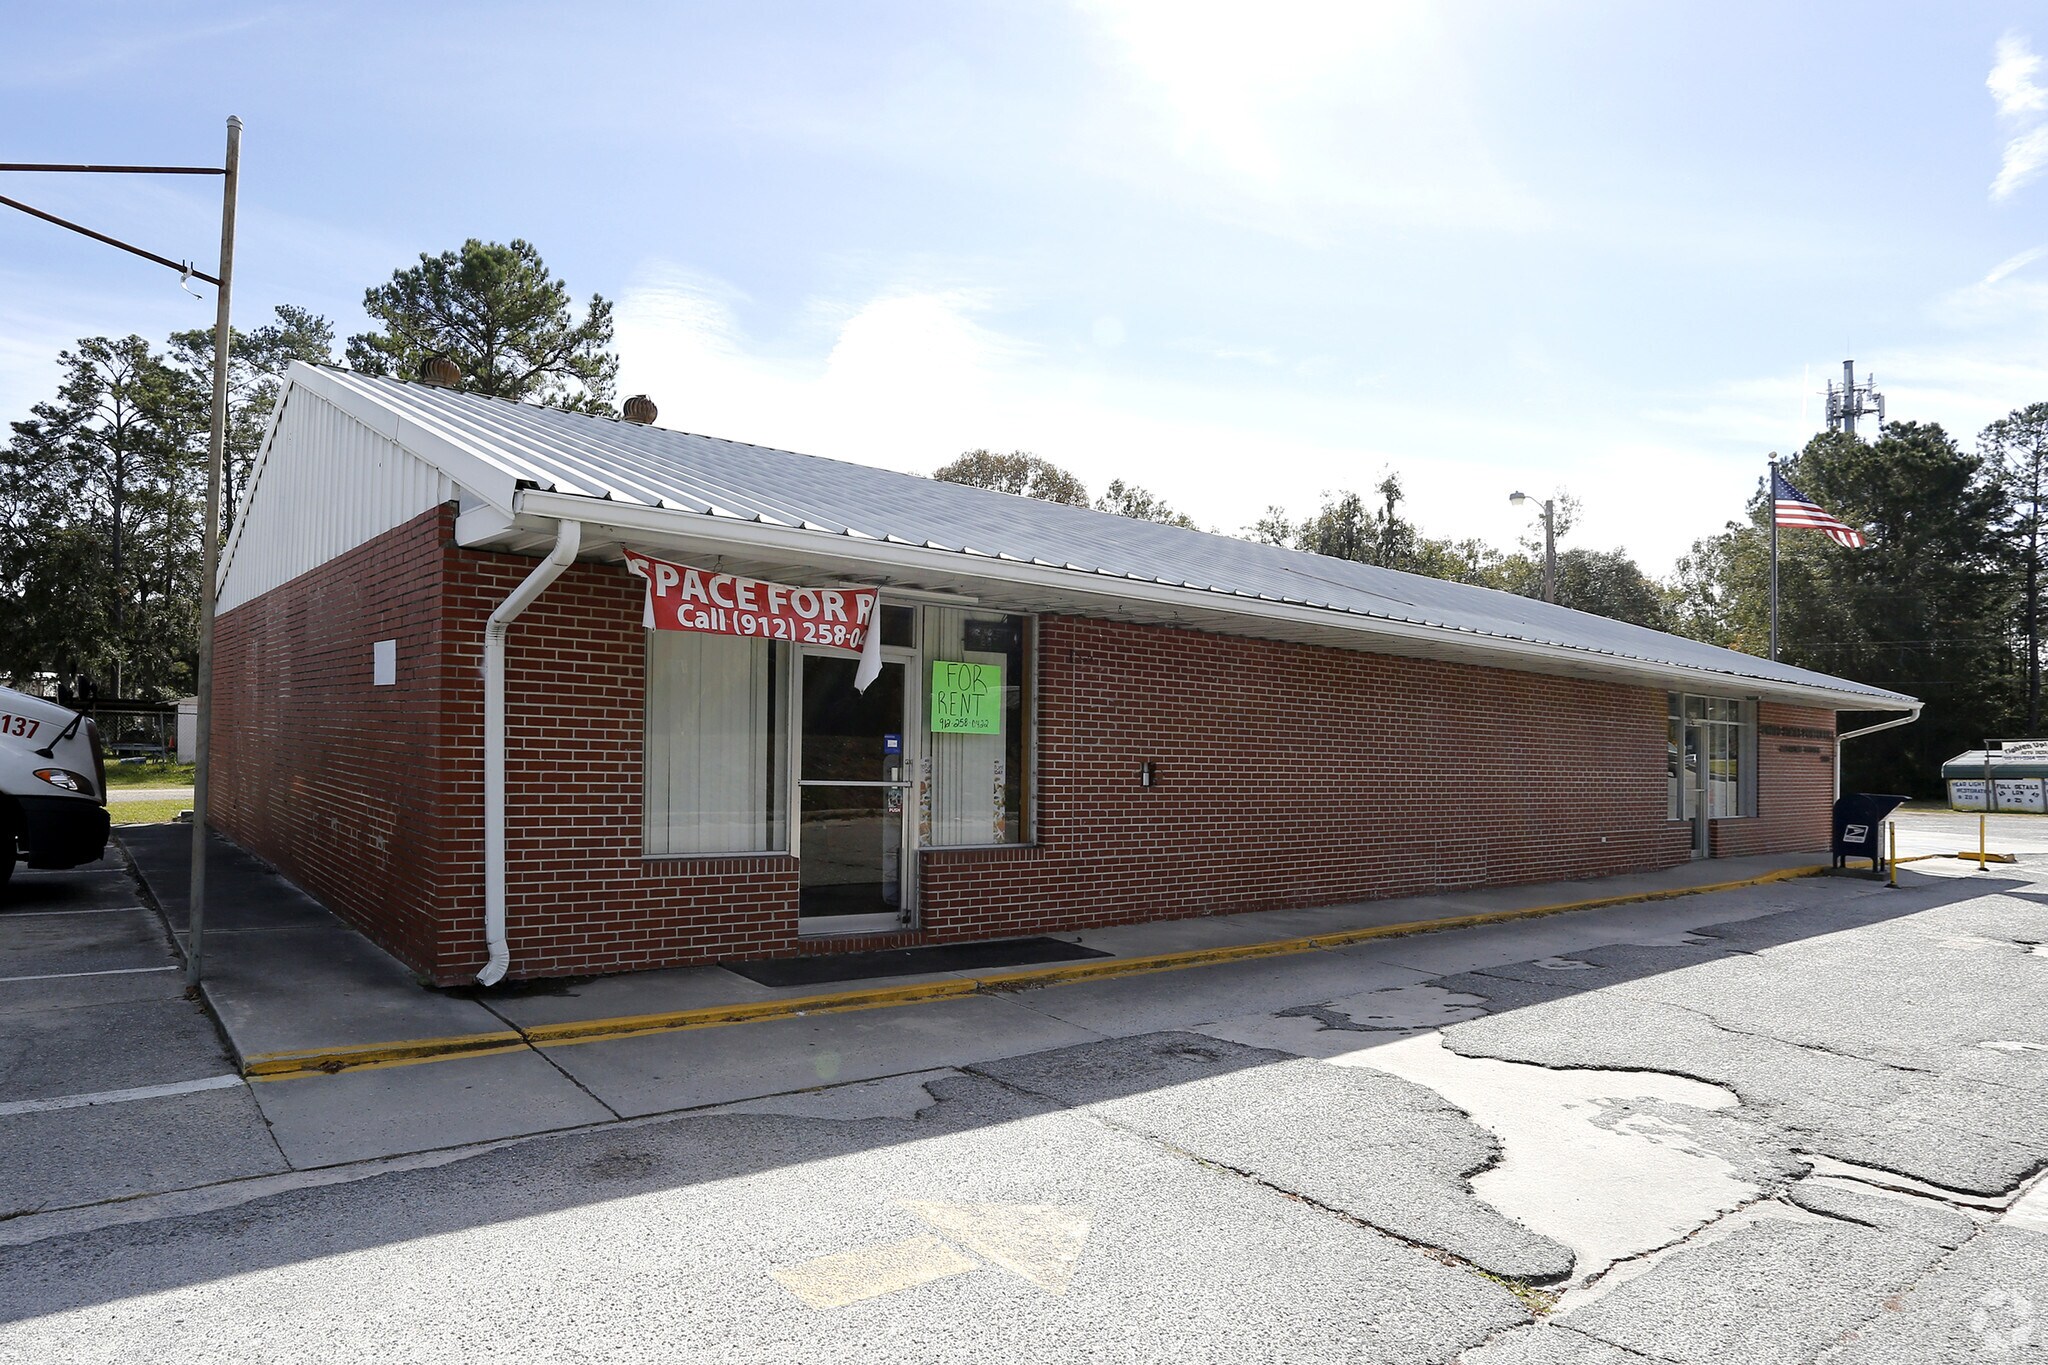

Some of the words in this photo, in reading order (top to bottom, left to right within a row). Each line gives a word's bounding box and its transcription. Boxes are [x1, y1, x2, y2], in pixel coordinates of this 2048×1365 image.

[768, 584, 848, 622] FOR
[677, 604, 726, 631] Call
[733, 611, 796, 641] (912)
[947, 663, 988, 693] FOR
[938, 690, 985, 717] RENT
[2, 714, 40, 739] 137
